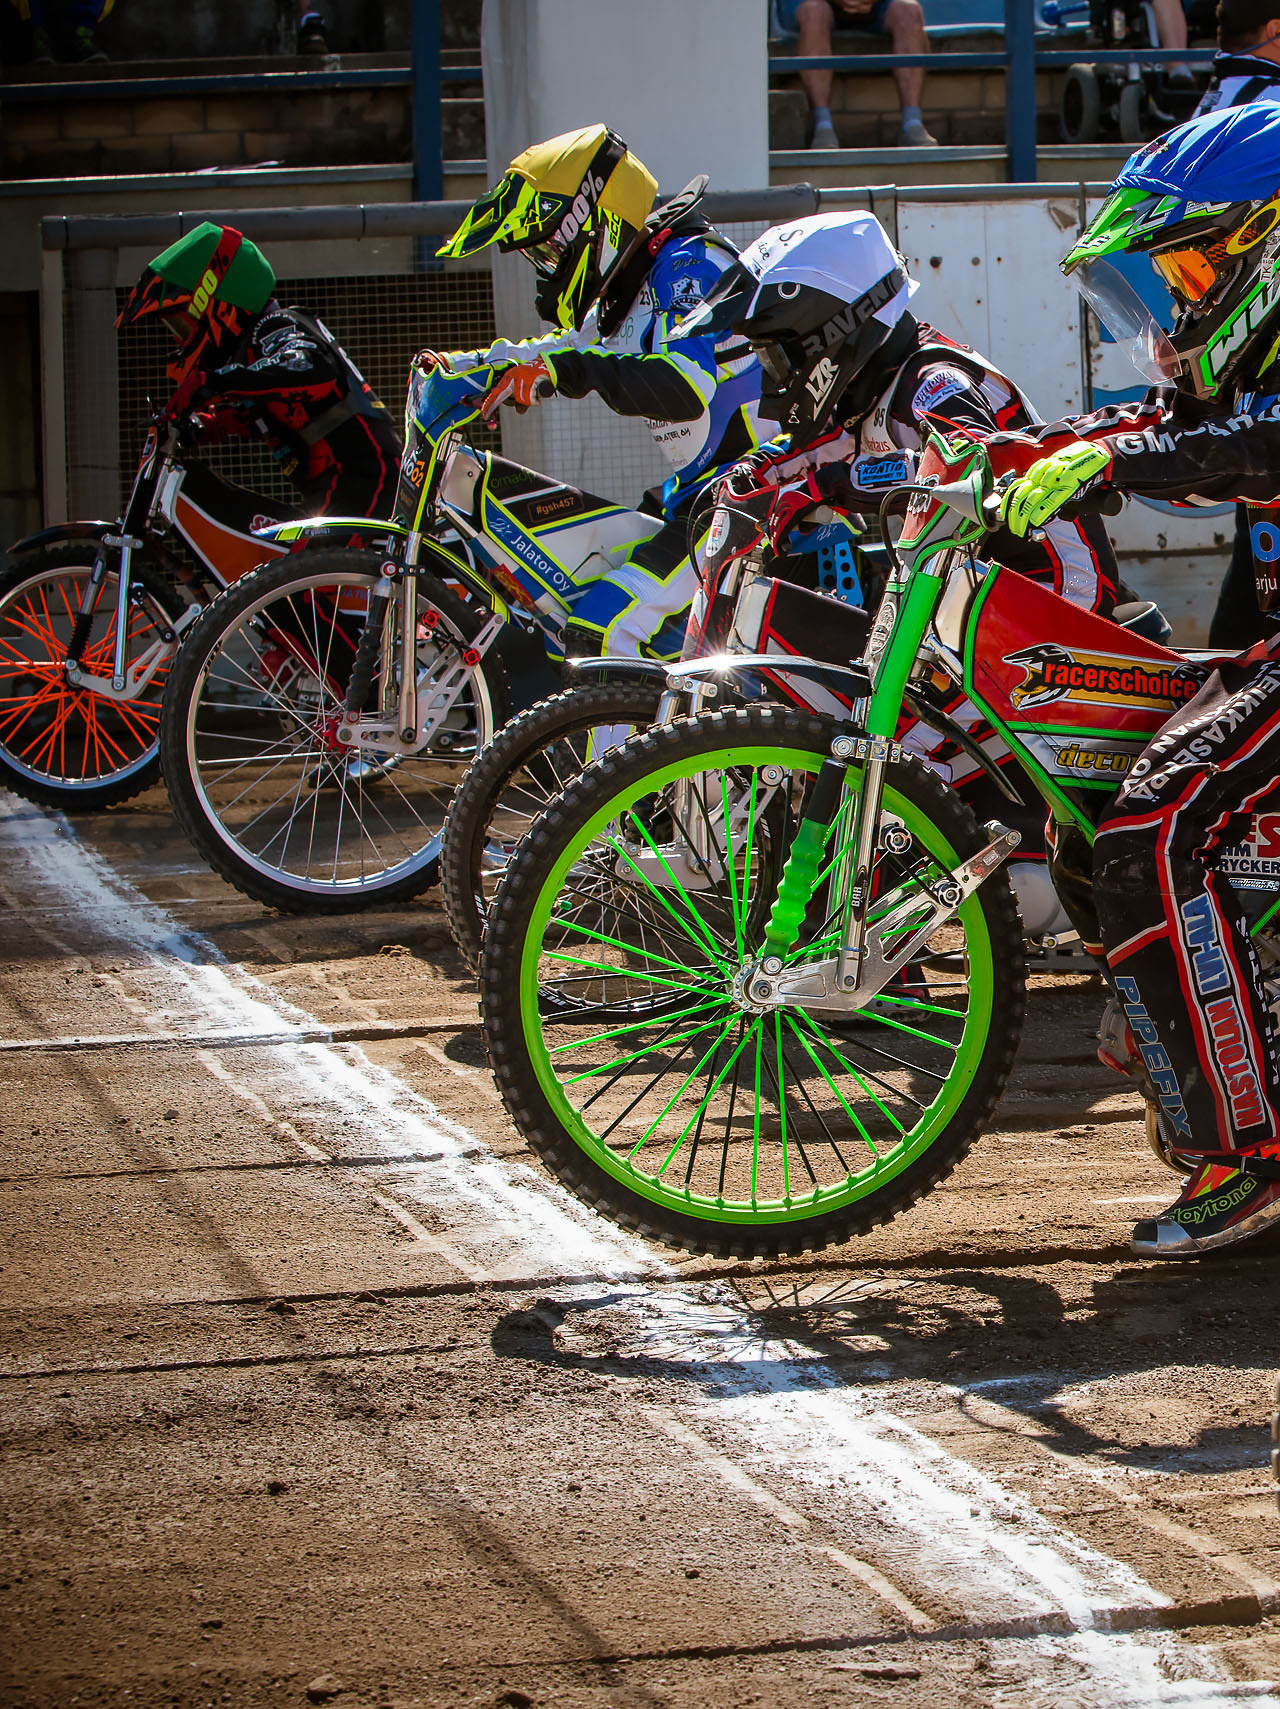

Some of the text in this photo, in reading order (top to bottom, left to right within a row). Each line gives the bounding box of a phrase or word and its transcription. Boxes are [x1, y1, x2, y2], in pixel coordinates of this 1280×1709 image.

[639, 290, 651, 306] 23
[535, 496, 576, 515] #gsh457
[510, 534, 571, 592] Jalator Oy
[1044, 660, 1197, 700] racerschoice
[1114, 975, 1193, 1138] PIPEFIX
[1204, 995, 1266, 1131] NASTOLAN
[1168, 1176, 1258, 1224] daytona
